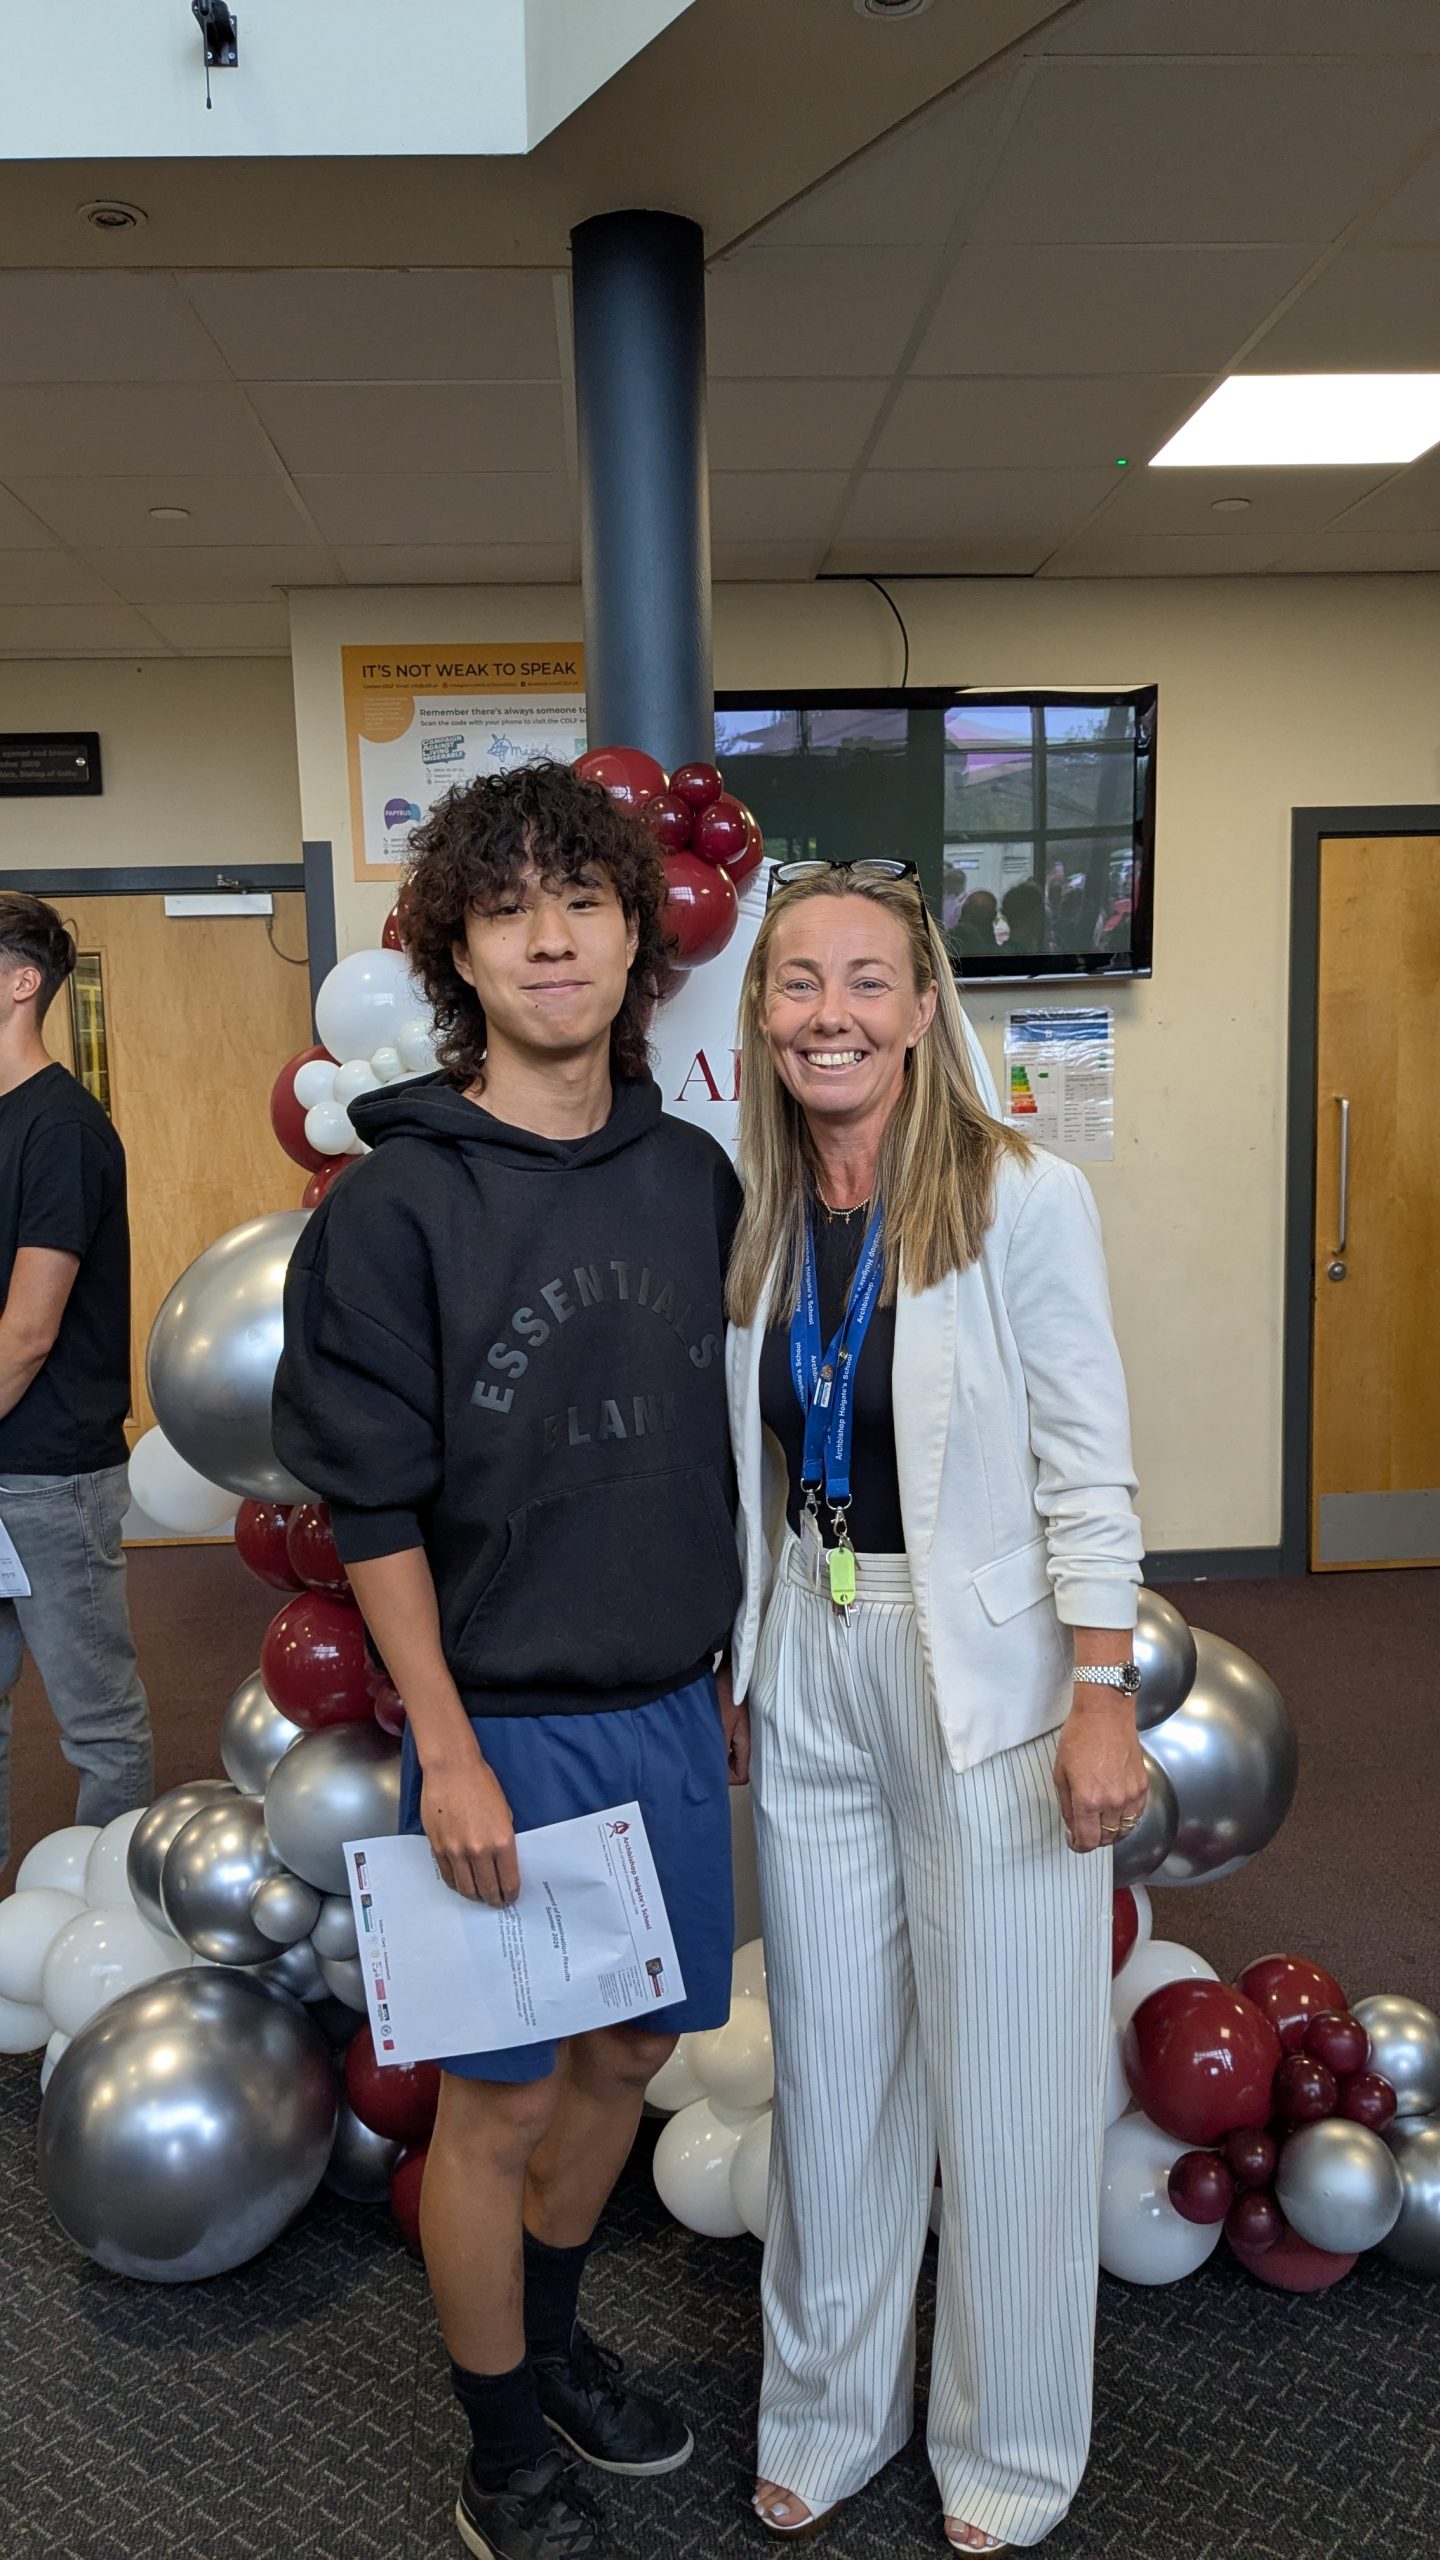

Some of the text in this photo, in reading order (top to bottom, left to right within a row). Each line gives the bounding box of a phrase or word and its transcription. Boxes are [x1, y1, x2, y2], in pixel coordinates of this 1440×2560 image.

[362, 661, 576, 678] IT'S NOT WEAK TO SPEAK
[420, 708, 469, 717] Remember
[472, 707, 502, 716] there's
[504, 707, 534, 717] always
[536, 706, 577, 714] someone
[501, 719, 521, 727] phone
[423, 735, 463, 746] CAMPAIGN
[423, 742, 455, 752] AGAINST
[423, 751, 464, 761] MISERABLY
[807, 1300, 815, 1326] School
[856, 1281, 875, 1324] Archbishop
[469, 1259, 721, 1415] ESSENTIALS
[834, 1353, 853, 1461] Archbishop Holgate's School
[623, 1836, 637, 1875] Archbishop
[633, 1875, 645, 1907] Holgate's
[641, 1907, 652, 1930] School
[545, 1905, 556, 1931] Summer
[552, 1906, 560, 1914] of
[555, 1914, 567, 1954] Examination
[562, 1955, 571, 1982] Results
